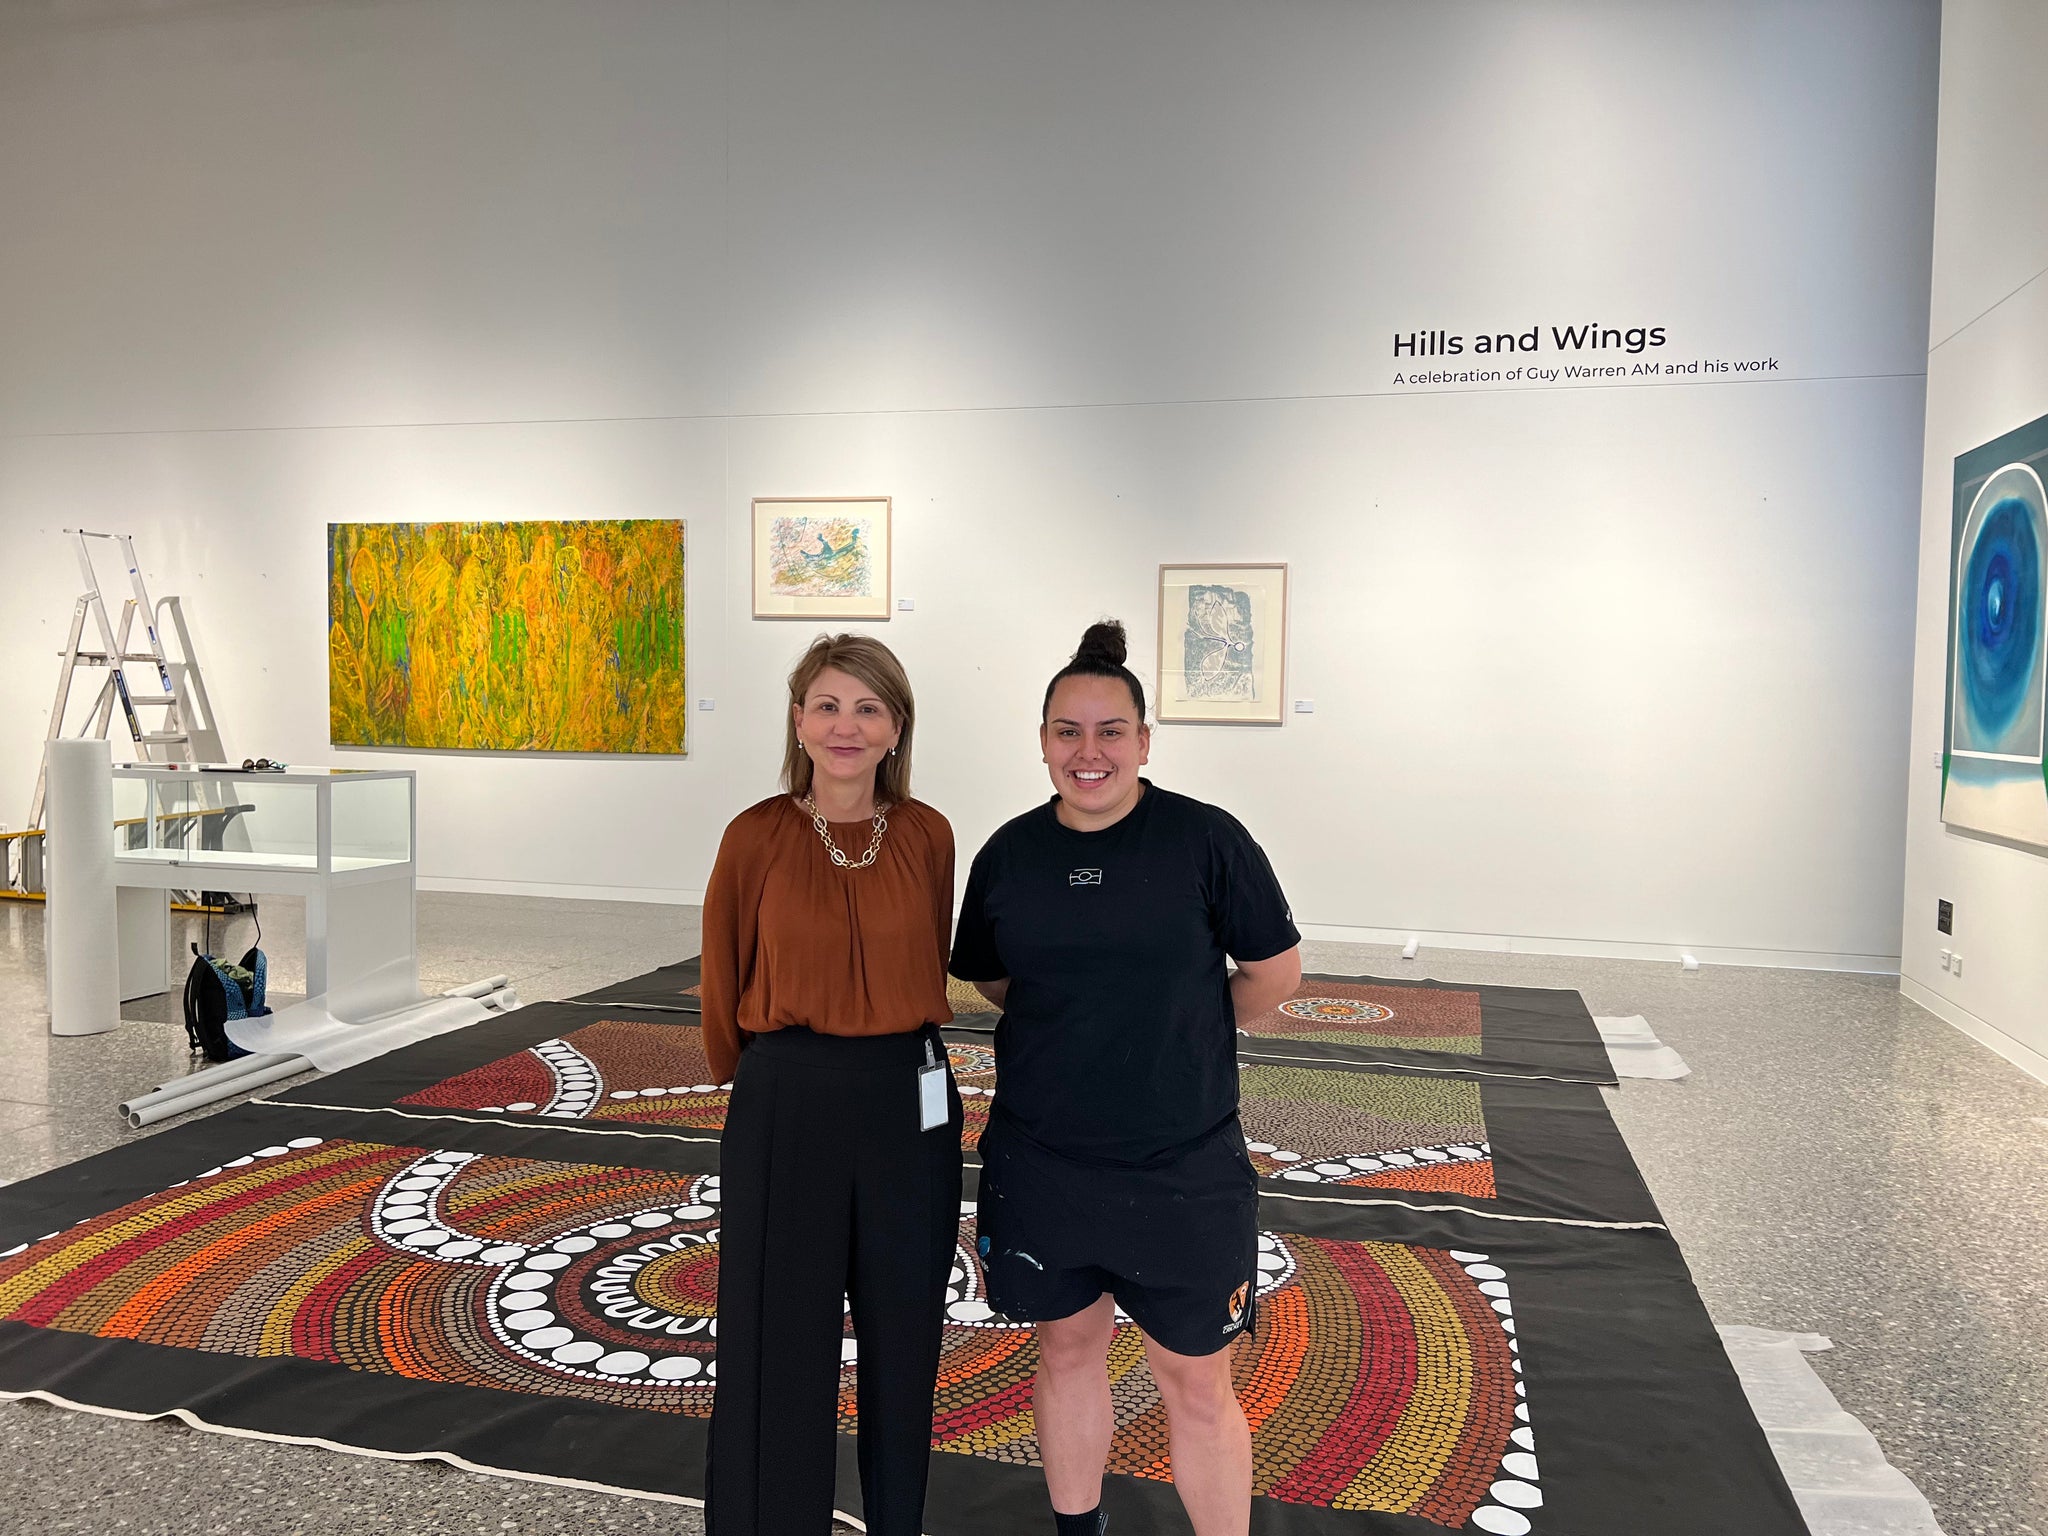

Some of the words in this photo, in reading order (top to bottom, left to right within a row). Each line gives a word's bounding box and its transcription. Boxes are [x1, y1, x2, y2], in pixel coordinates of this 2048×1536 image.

[1393, 330, 1464, 358] Hills
[1474, 326, 1539, 354] and
[1551, 322, 1667, 355] Wings
[1393, 372, 1406, 385] A
[1408, 369, 1501, 385] celebration
[1505, 366, 1524, 381] of
[1526, 367, 1560, 382] Guy
[1563, 365, 1627, 379] Warren
[1630, 362, 1660, 376] AM
[1664, 359, 1699, 375] and
[1703, 359, 1729, 374] his
[1733, 356, 1780, 372] work
